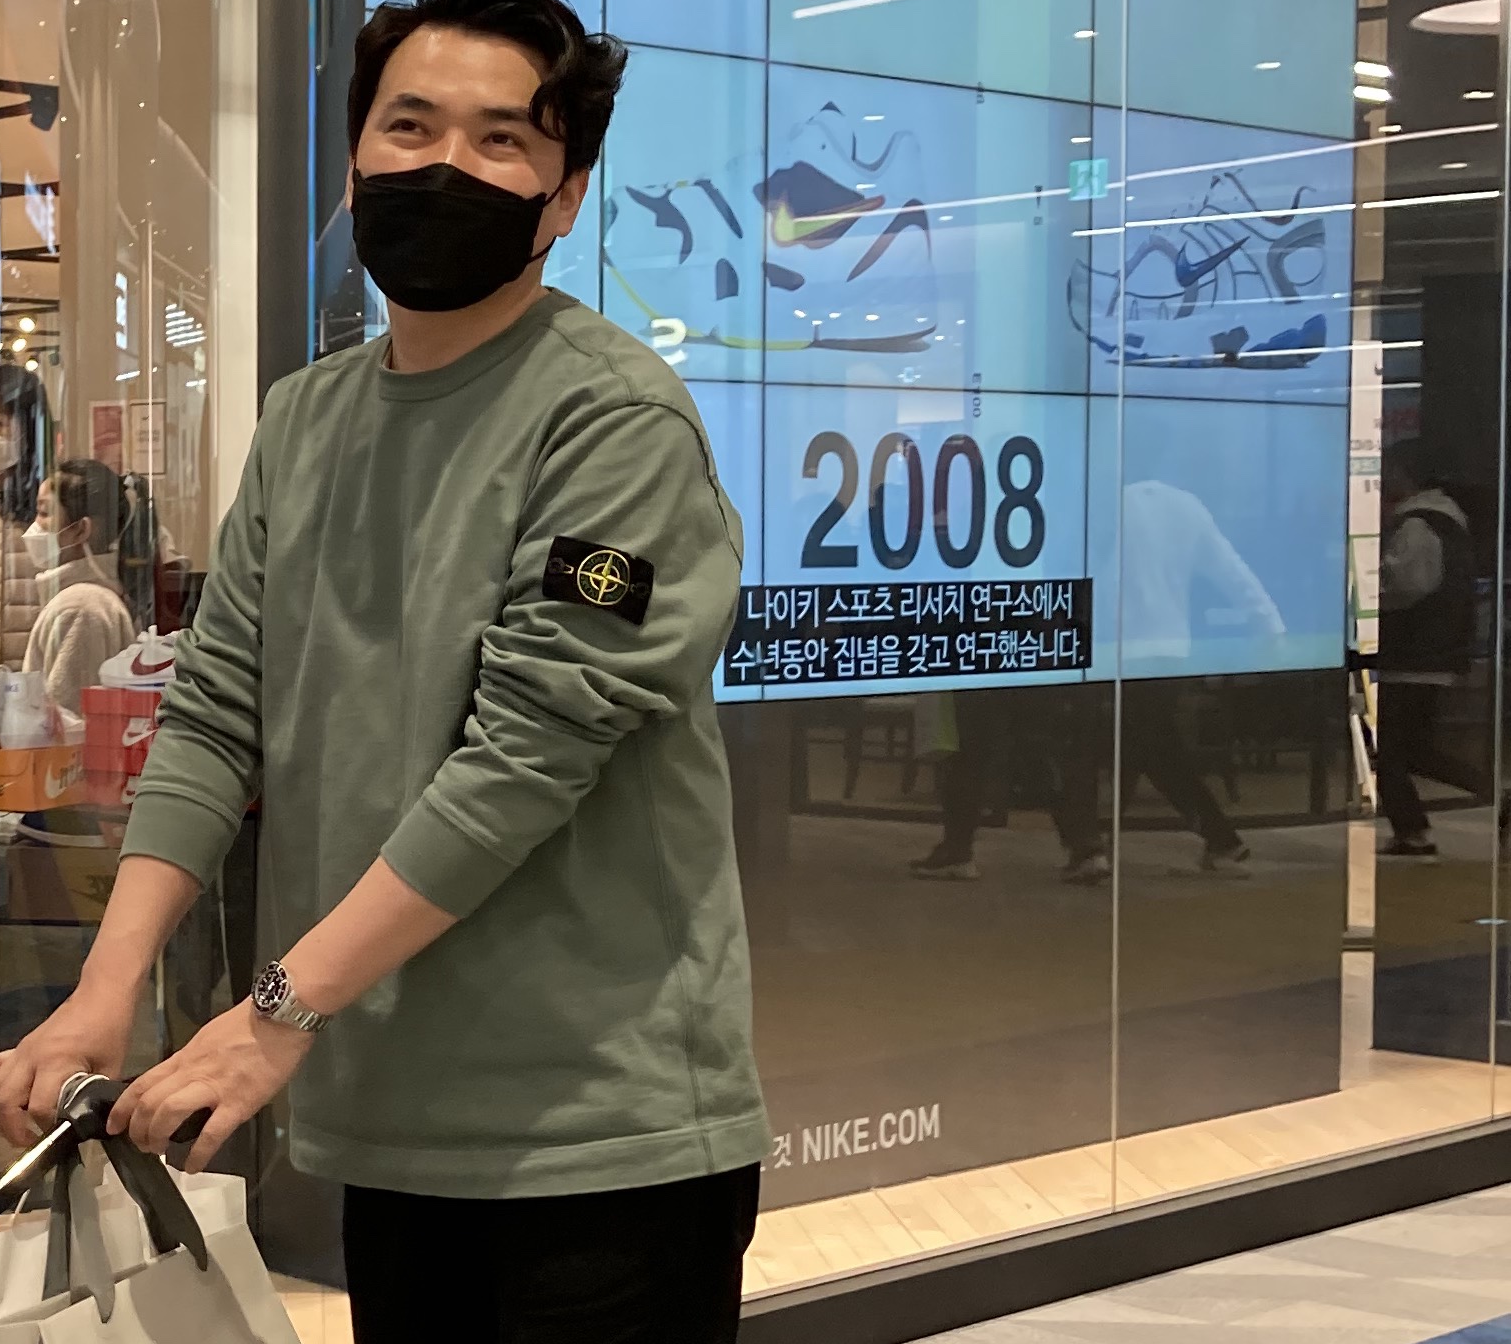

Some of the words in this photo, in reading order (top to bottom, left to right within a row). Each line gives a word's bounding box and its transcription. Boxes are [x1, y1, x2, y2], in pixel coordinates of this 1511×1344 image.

[800, 430, 1046, 570] 2008
[746, 587, 820, 631] 나이키
[825, 585, 895, 623] 스포츠
[900, 584, 964, 624] 리서치
[970, 582, 1073, 623] 연구소에서
[730, 637, 830, 682] 수년동안
[833, 634, 902, 677] 집념을
[907, 633, 951, 673] 갖고
[955, 628, 1085, 671] 연구했습니다.
[772, 1132, 792, 1169] 것
[801, 1103, 940, 1164] NIKE.COM
